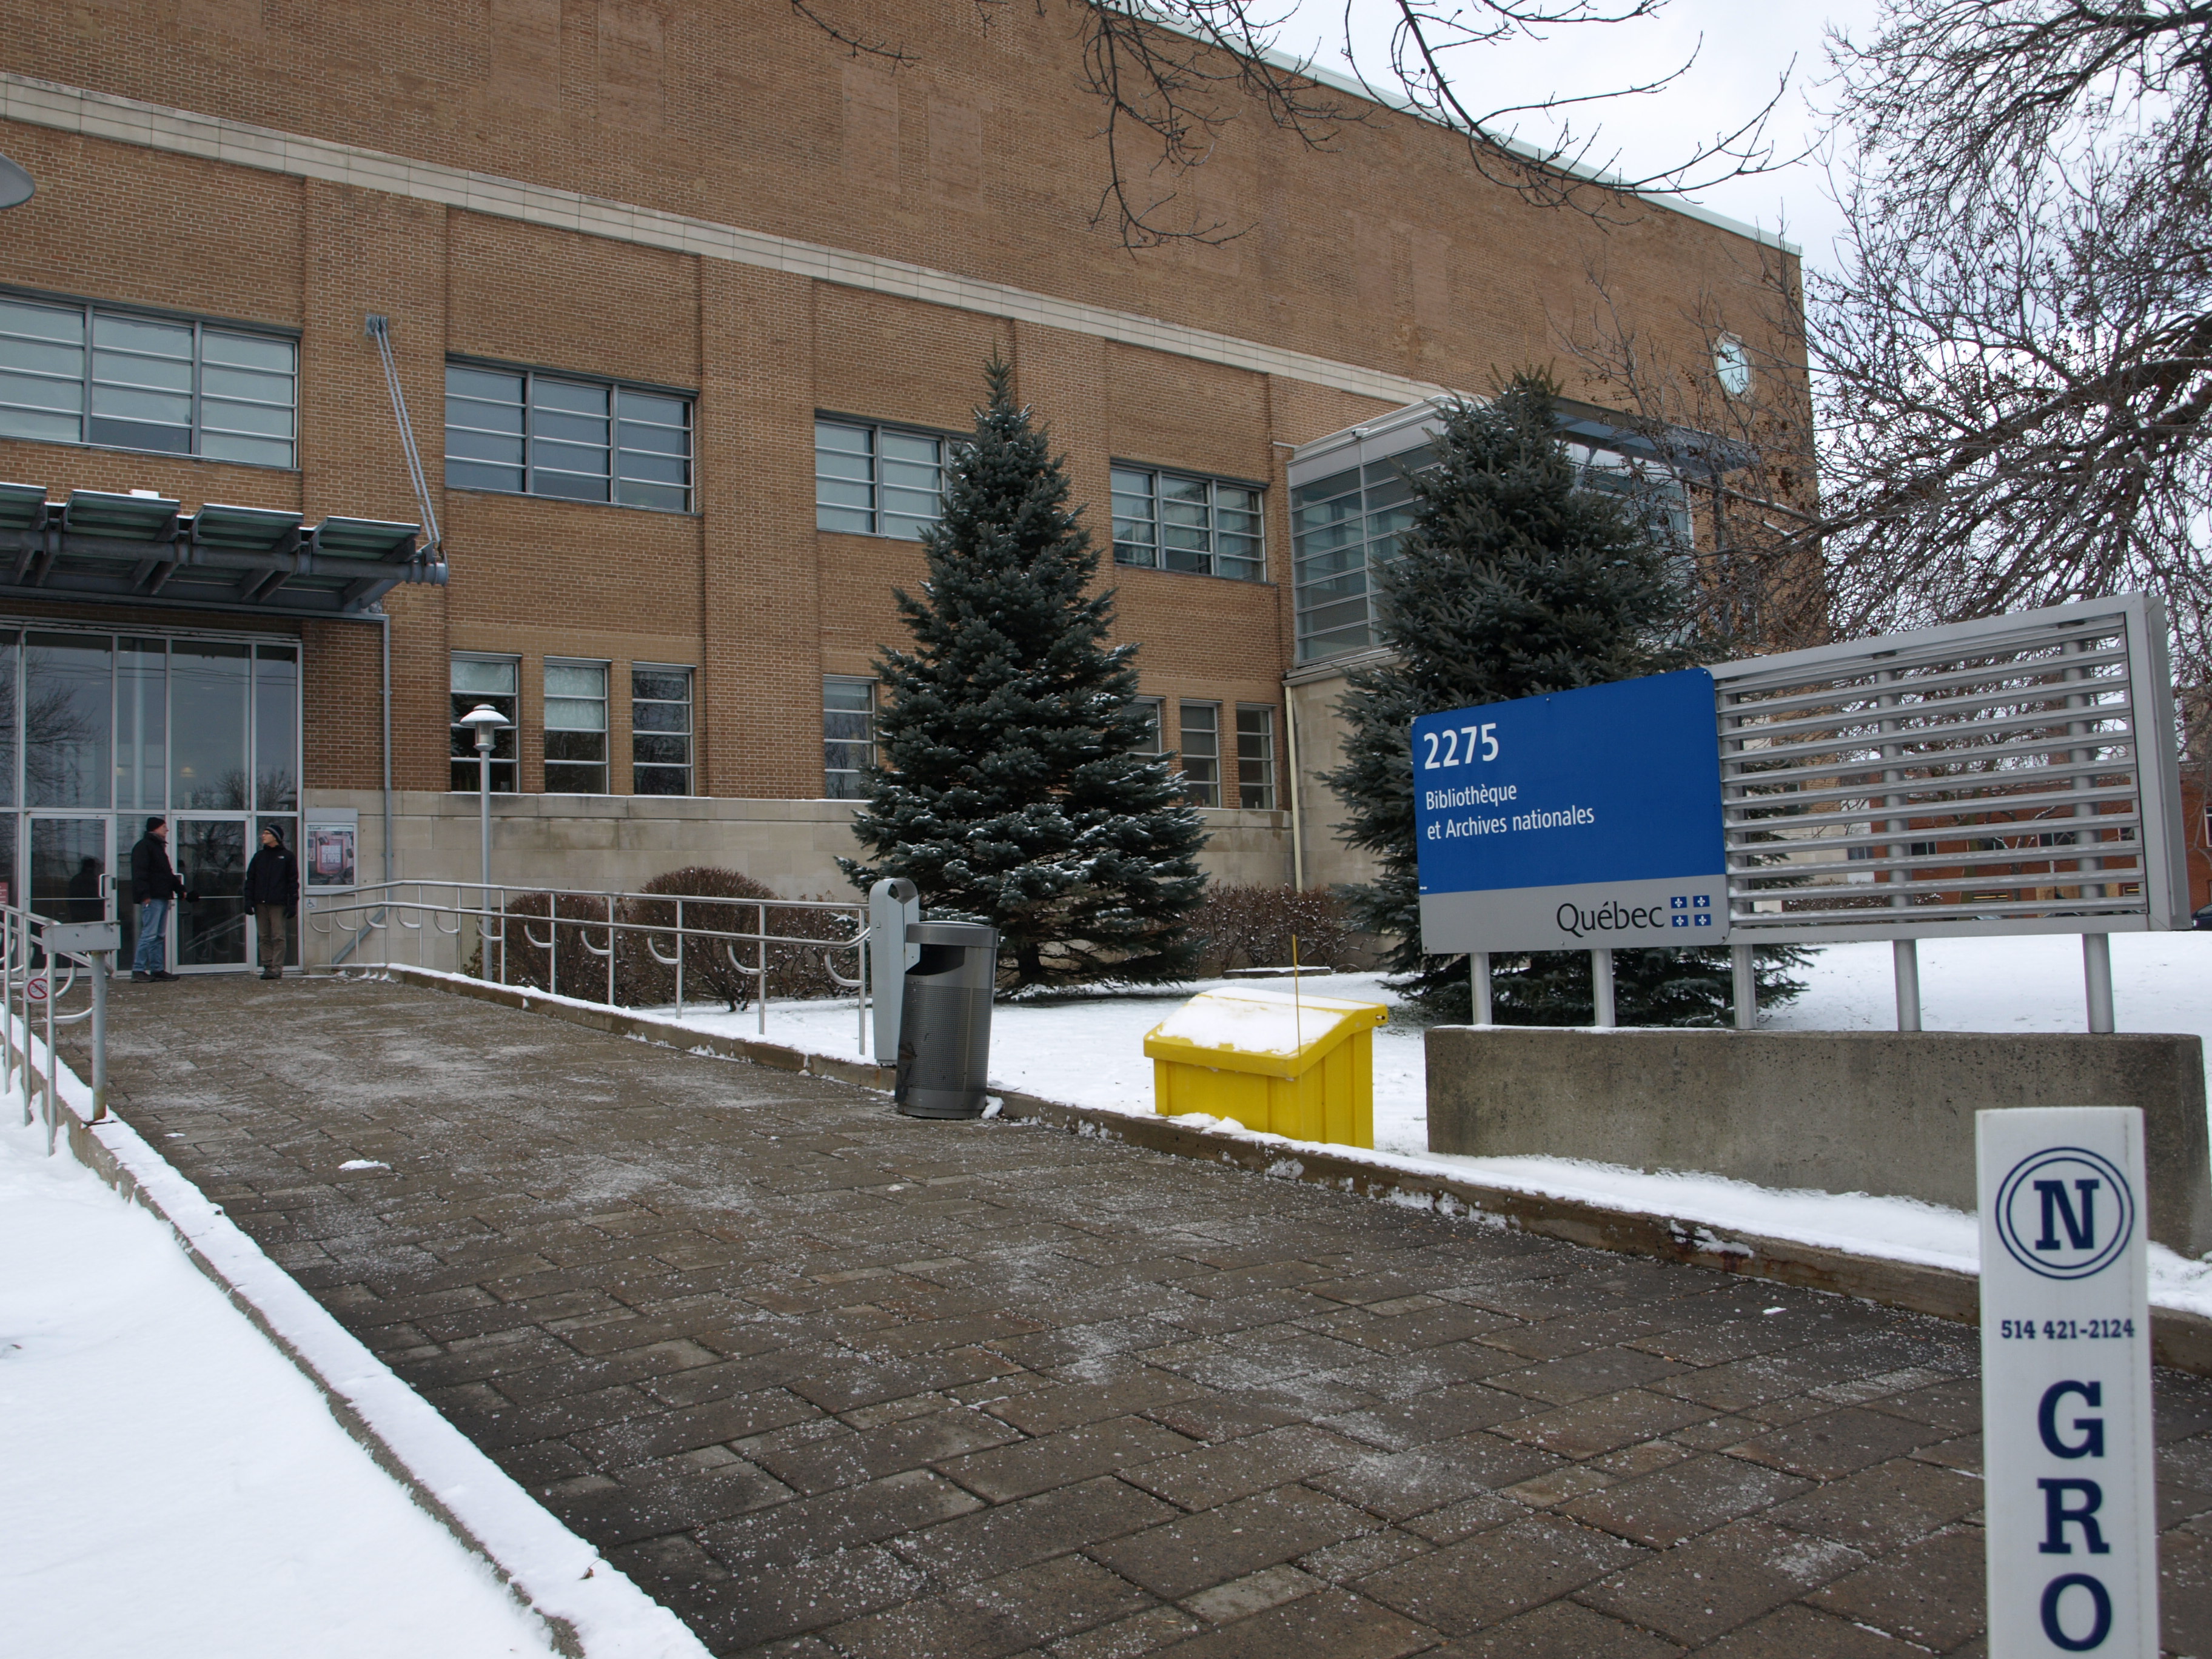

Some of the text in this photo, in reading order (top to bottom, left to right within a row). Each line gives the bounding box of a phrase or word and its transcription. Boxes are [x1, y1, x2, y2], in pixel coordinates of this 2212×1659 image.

[1424, 722, 1500, 770] 2275
[1426, 783, 1517, 810] Bibliothèque
[1427, 805, 1595, 840] et Archives nationales
[1557, 900, 1664, 938] Québec
[2033, 1179, 2100, 1250] N
[2001, 1319, 2136, 1339] 514 421-2124
